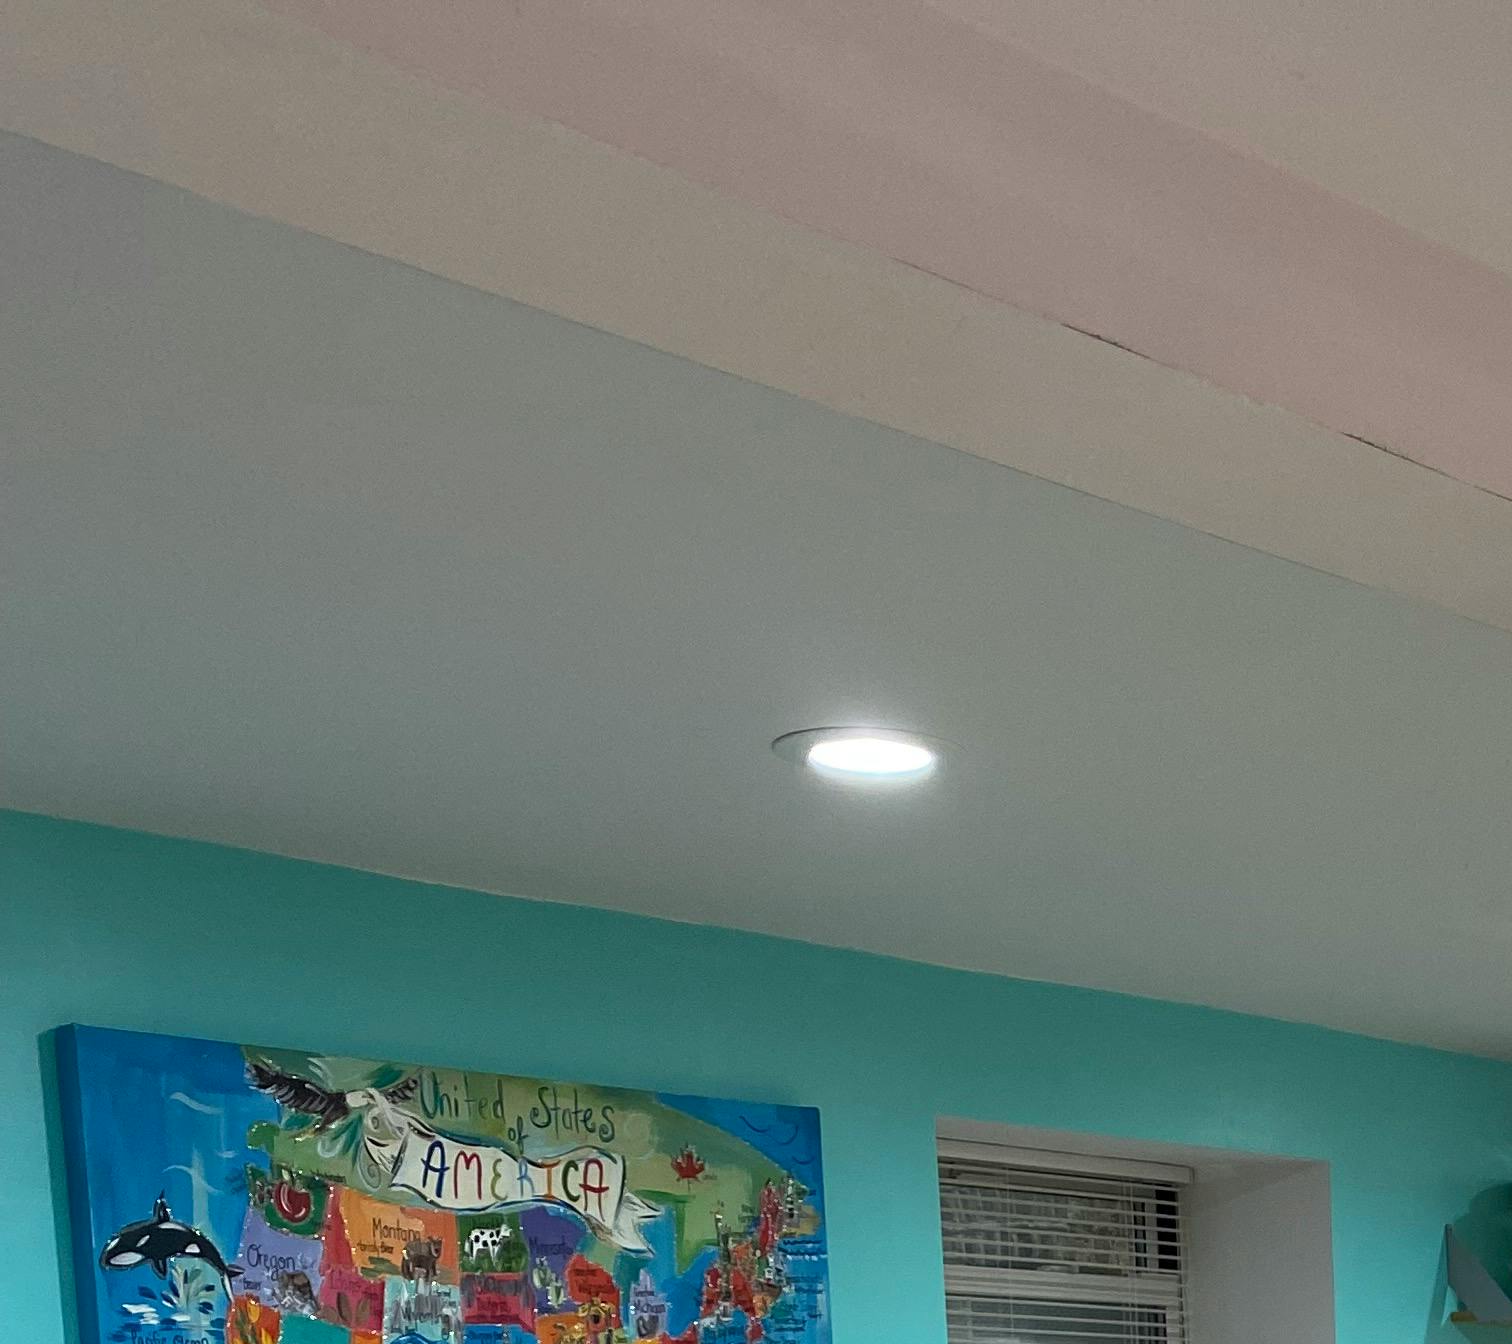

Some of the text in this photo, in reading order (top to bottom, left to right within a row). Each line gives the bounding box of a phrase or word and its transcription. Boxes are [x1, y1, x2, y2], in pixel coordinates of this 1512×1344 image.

[419, 1068, 616, 1143] United States
[507, 1116, 529, 1157] of
[421, 1141, 609, 1222] AMERICA
[372, 1218, 421, 1242] Montana
[247, 1244, 295, 1279] Oregon
